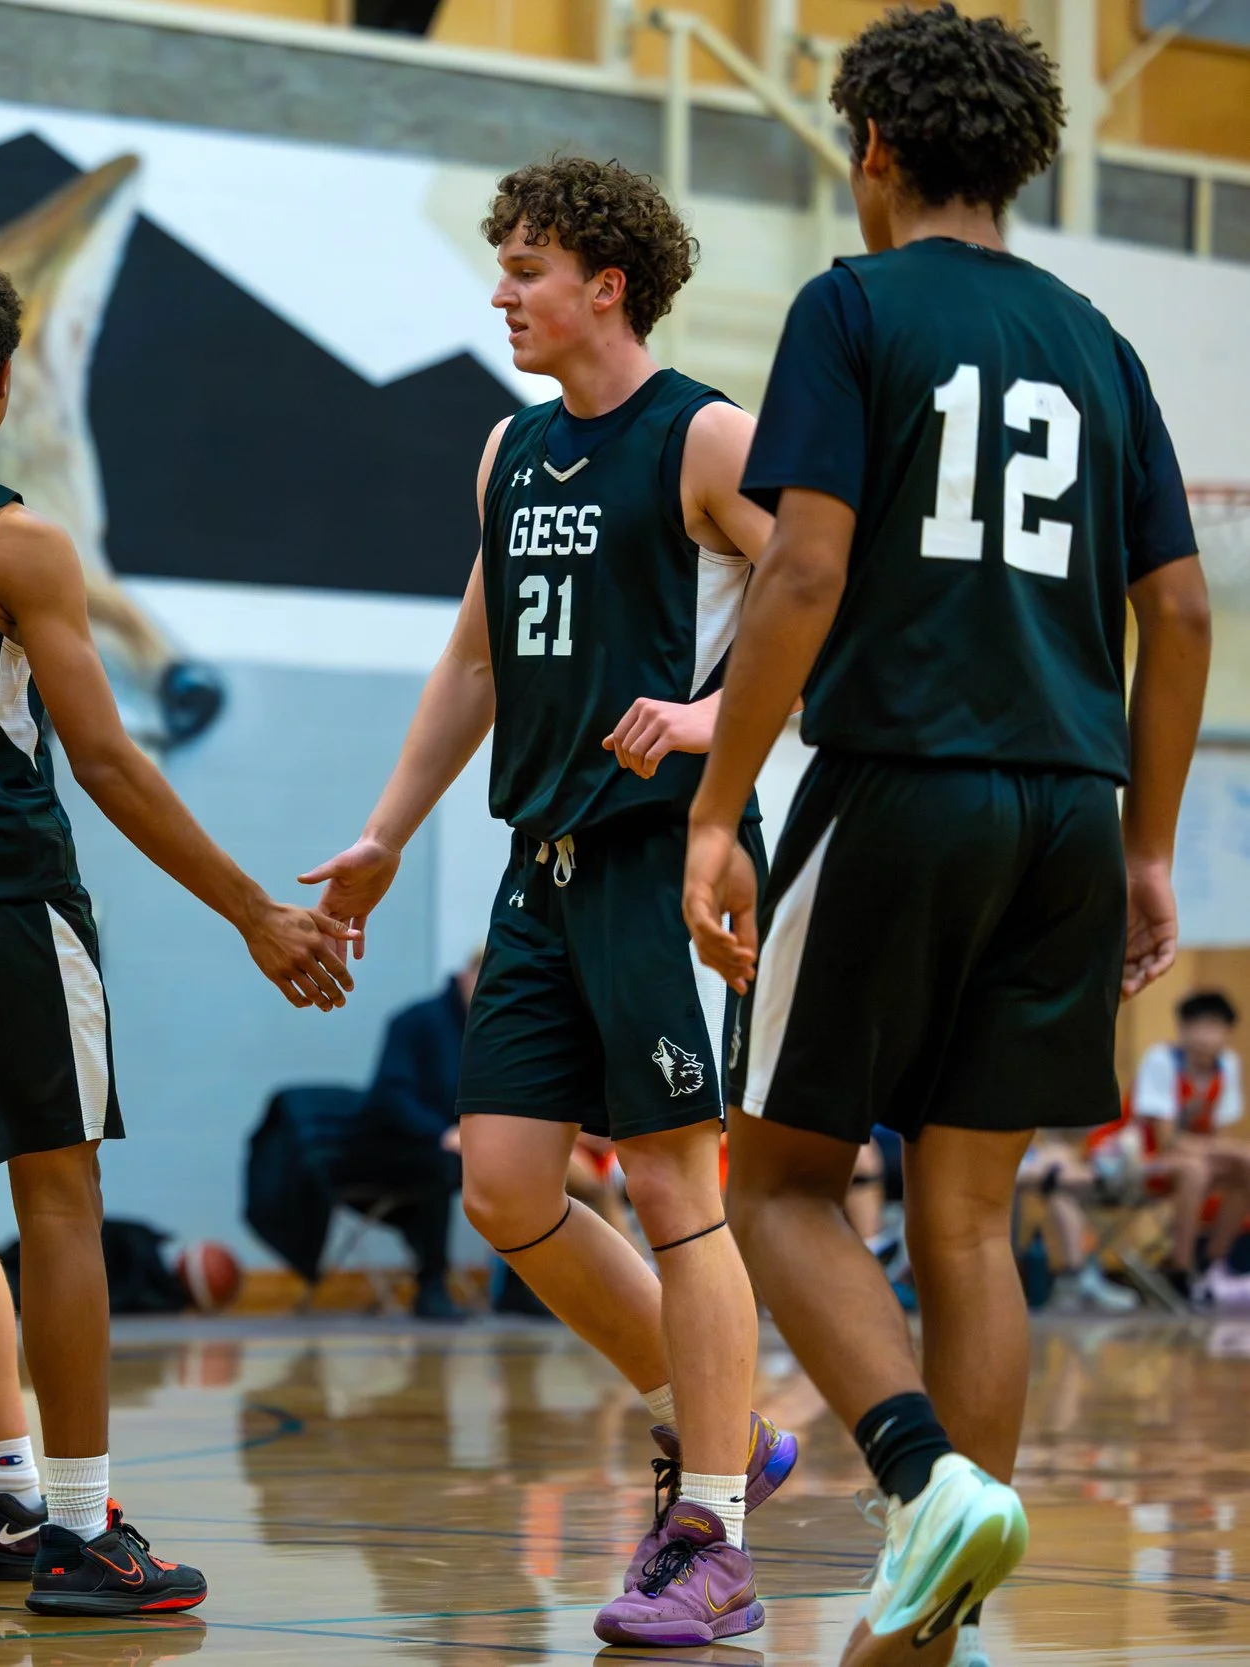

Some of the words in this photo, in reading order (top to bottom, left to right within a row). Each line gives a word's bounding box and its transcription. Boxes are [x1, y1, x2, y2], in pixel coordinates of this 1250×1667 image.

[920, 363, 1081, 579] 12
[508, 505, 602, 557] GESS
[517, 574, 573, 657] 21
